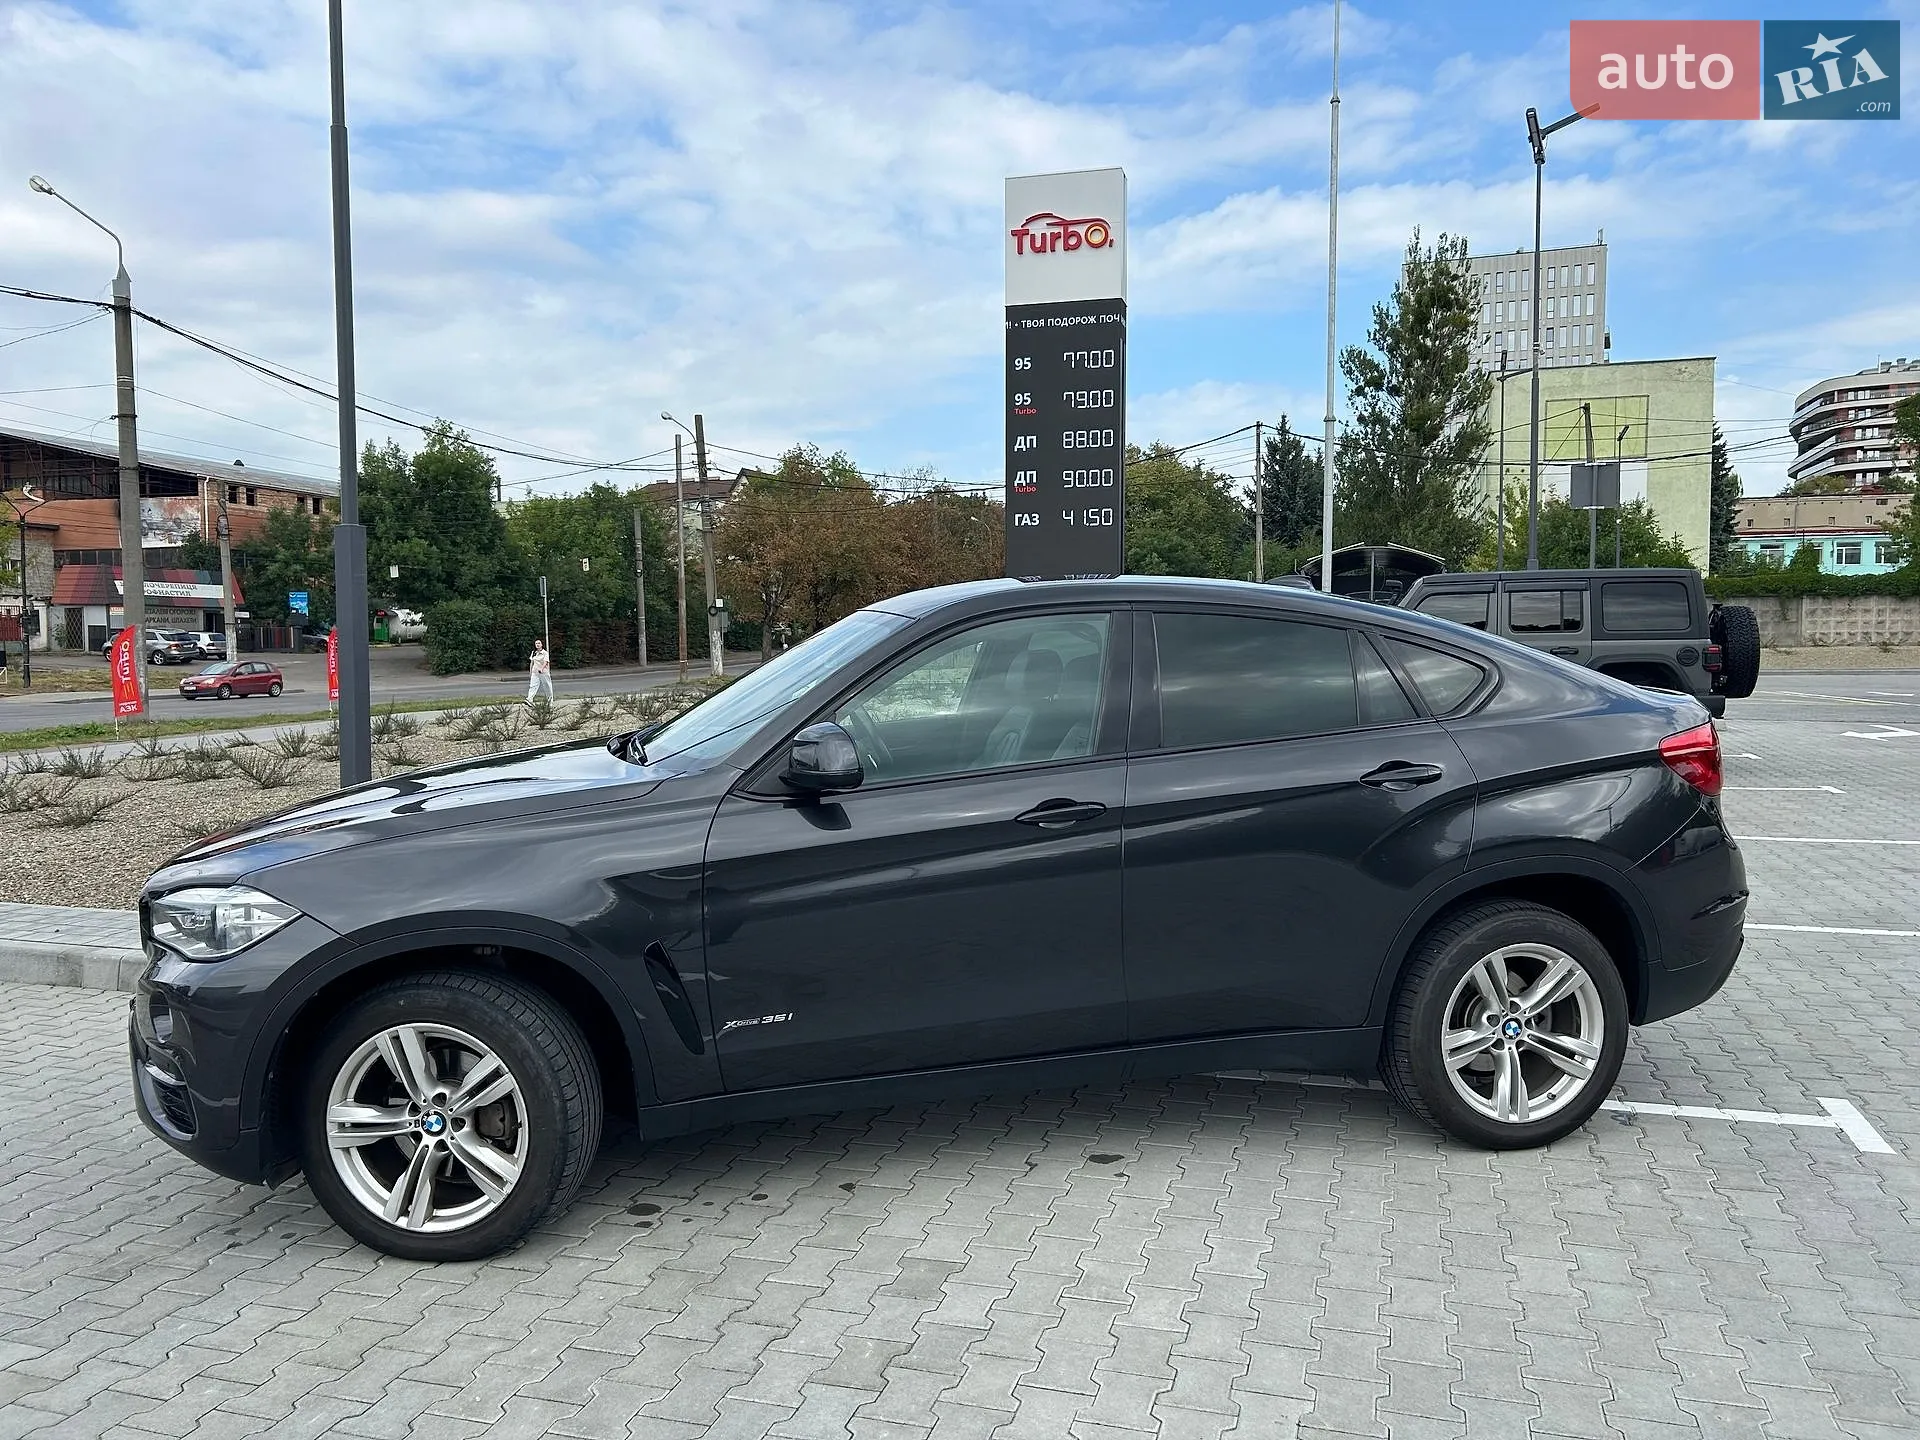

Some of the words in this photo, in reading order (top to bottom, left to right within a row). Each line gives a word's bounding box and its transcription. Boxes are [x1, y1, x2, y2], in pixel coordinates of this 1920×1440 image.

[1021, 318, 1045, 329] ТВОЯ
[1047, 315, 1097, 327] ПОДОРОЖ
[1014, 357, 1032, 370] 95
[1063, 349, 1115, 369] 77.00
[1014, 392, 1032, 406] 95
[1063, 389, 1115, 409] 79.00
[1014, 435, 1037, 452] ДП
[1062, 429, 1115, 449] 88.00
[1014, 470, 1037, 487] ДП
[1062, 469, 1114, 488] 90.00
[1014, 513, 1040, 526] ГАЗ
[145, 589, 192, 597] ОФНАСТИЛ
